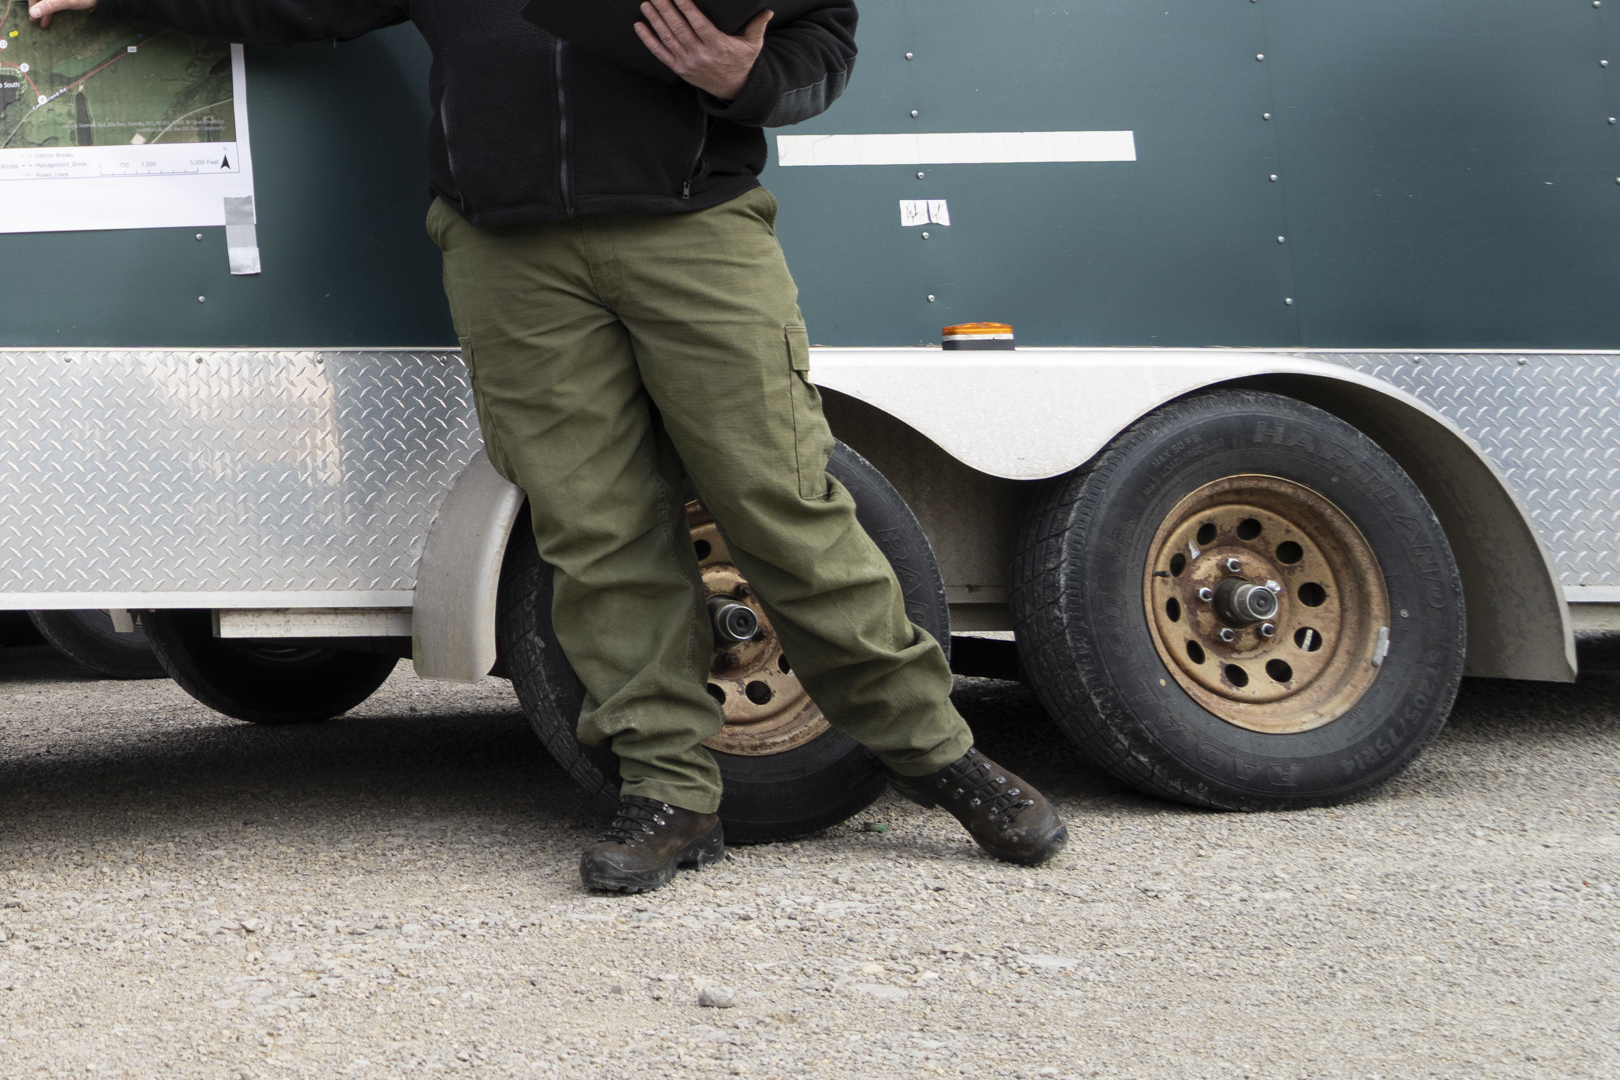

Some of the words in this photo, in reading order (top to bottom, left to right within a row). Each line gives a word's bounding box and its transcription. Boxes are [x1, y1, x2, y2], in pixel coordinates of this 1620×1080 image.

[3, 81, 20, 89] South
[1142, 475, 1161, 496] MAX
[1159, 457, 1181, 479] LOAD
[1204, 438, 1225, 451] LBS
[1151, 450, 1171, 469] MAX
[1171, 441, 1186, 454] 50
[1185, 433, 1202, 446] PSI
[1252, 421, 1447, 609] HARTLAND
[1133, 680, 1303, 788] RADIAL
